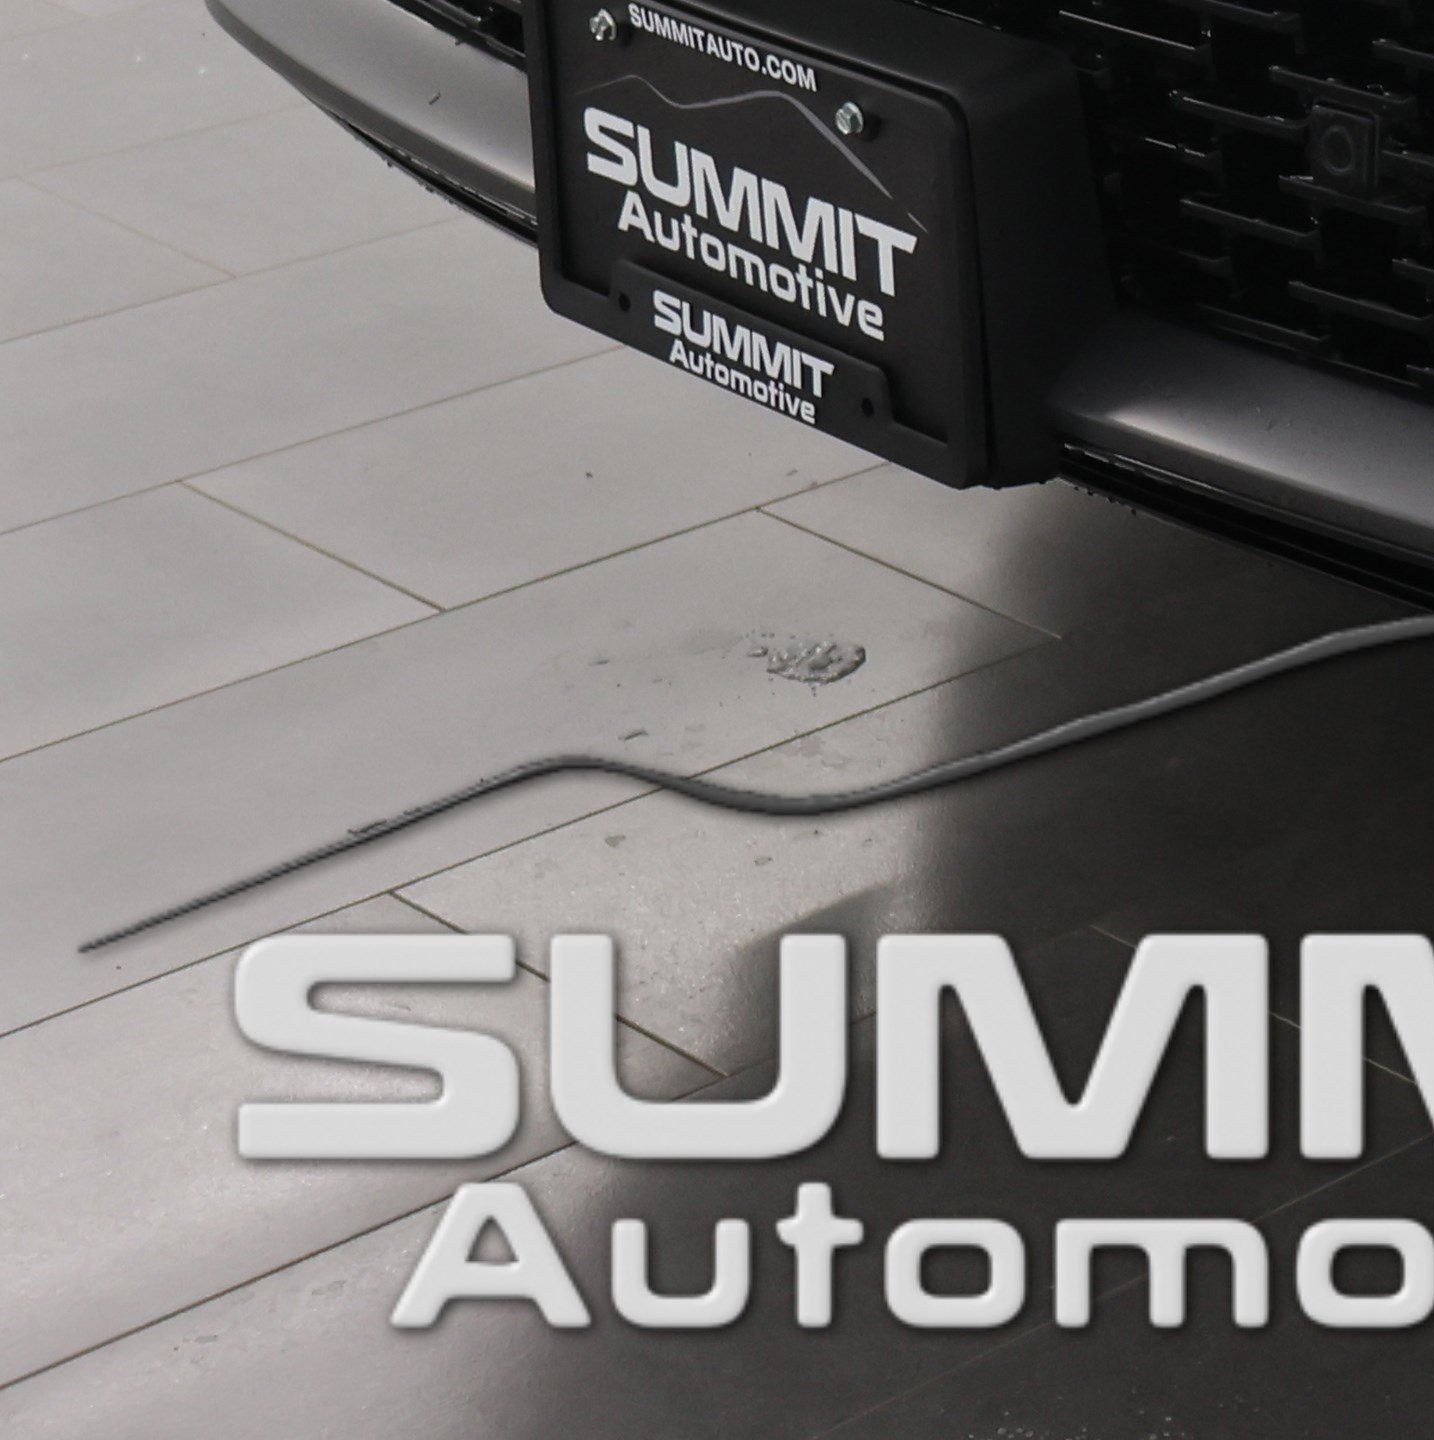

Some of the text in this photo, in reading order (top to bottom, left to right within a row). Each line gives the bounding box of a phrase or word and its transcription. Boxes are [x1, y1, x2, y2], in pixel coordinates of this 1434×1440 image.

[627, 2, 819, 93] SUMMITAUTO.COM
[583, 106, 918, 298] SUMMIT
[617, 191, 886, 341] Automotive
[653, 289, 835, 398] SUMMIT
[669, 339, 816, 425] Automotive
